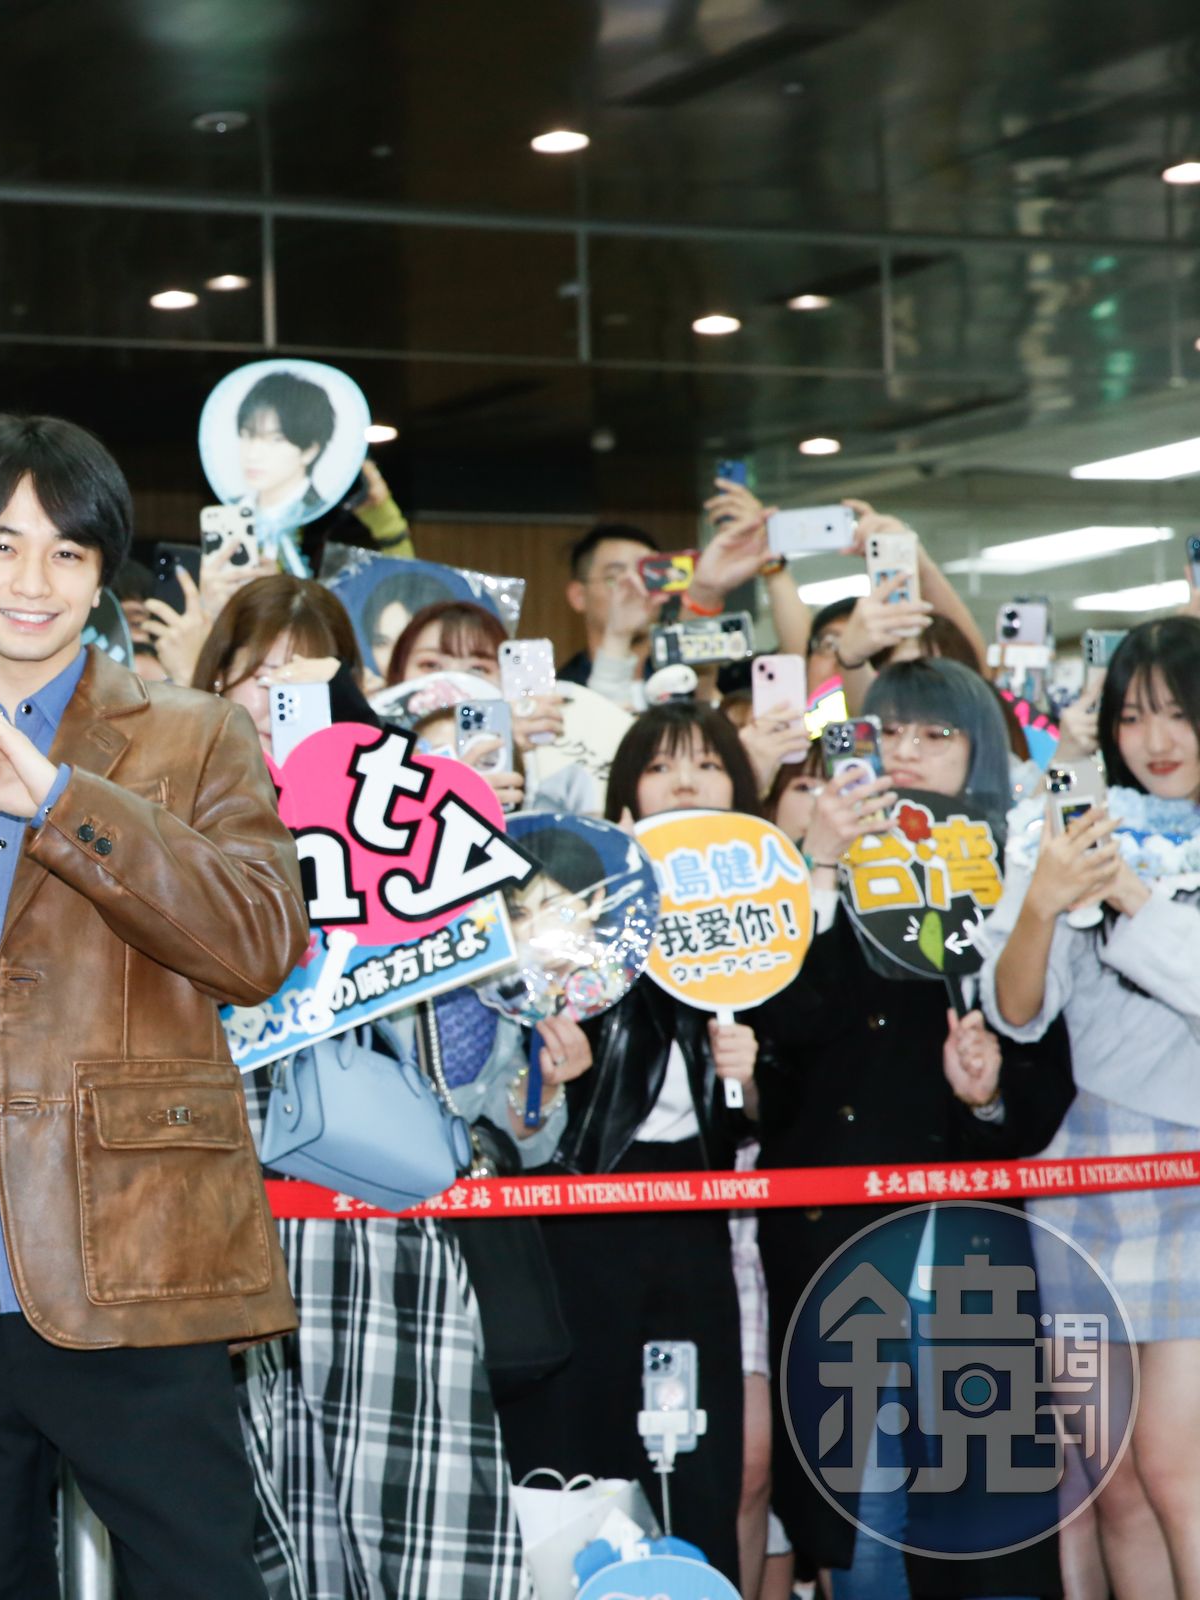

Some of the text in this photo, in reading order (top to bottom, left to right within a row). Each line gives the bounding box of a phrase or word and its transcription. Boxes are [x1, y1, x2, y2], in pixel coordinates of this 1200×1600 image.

[655, 839, 799, 898] 島健人
[864, 1168, 1011, 1197] 臺北國際航空站
[1017, 1157, 1198, 1188] TAIPEI INTERNATIONAL
[501, 1178, 770, 1208] TAIPEI INTERNATIONAL AIRPORT
